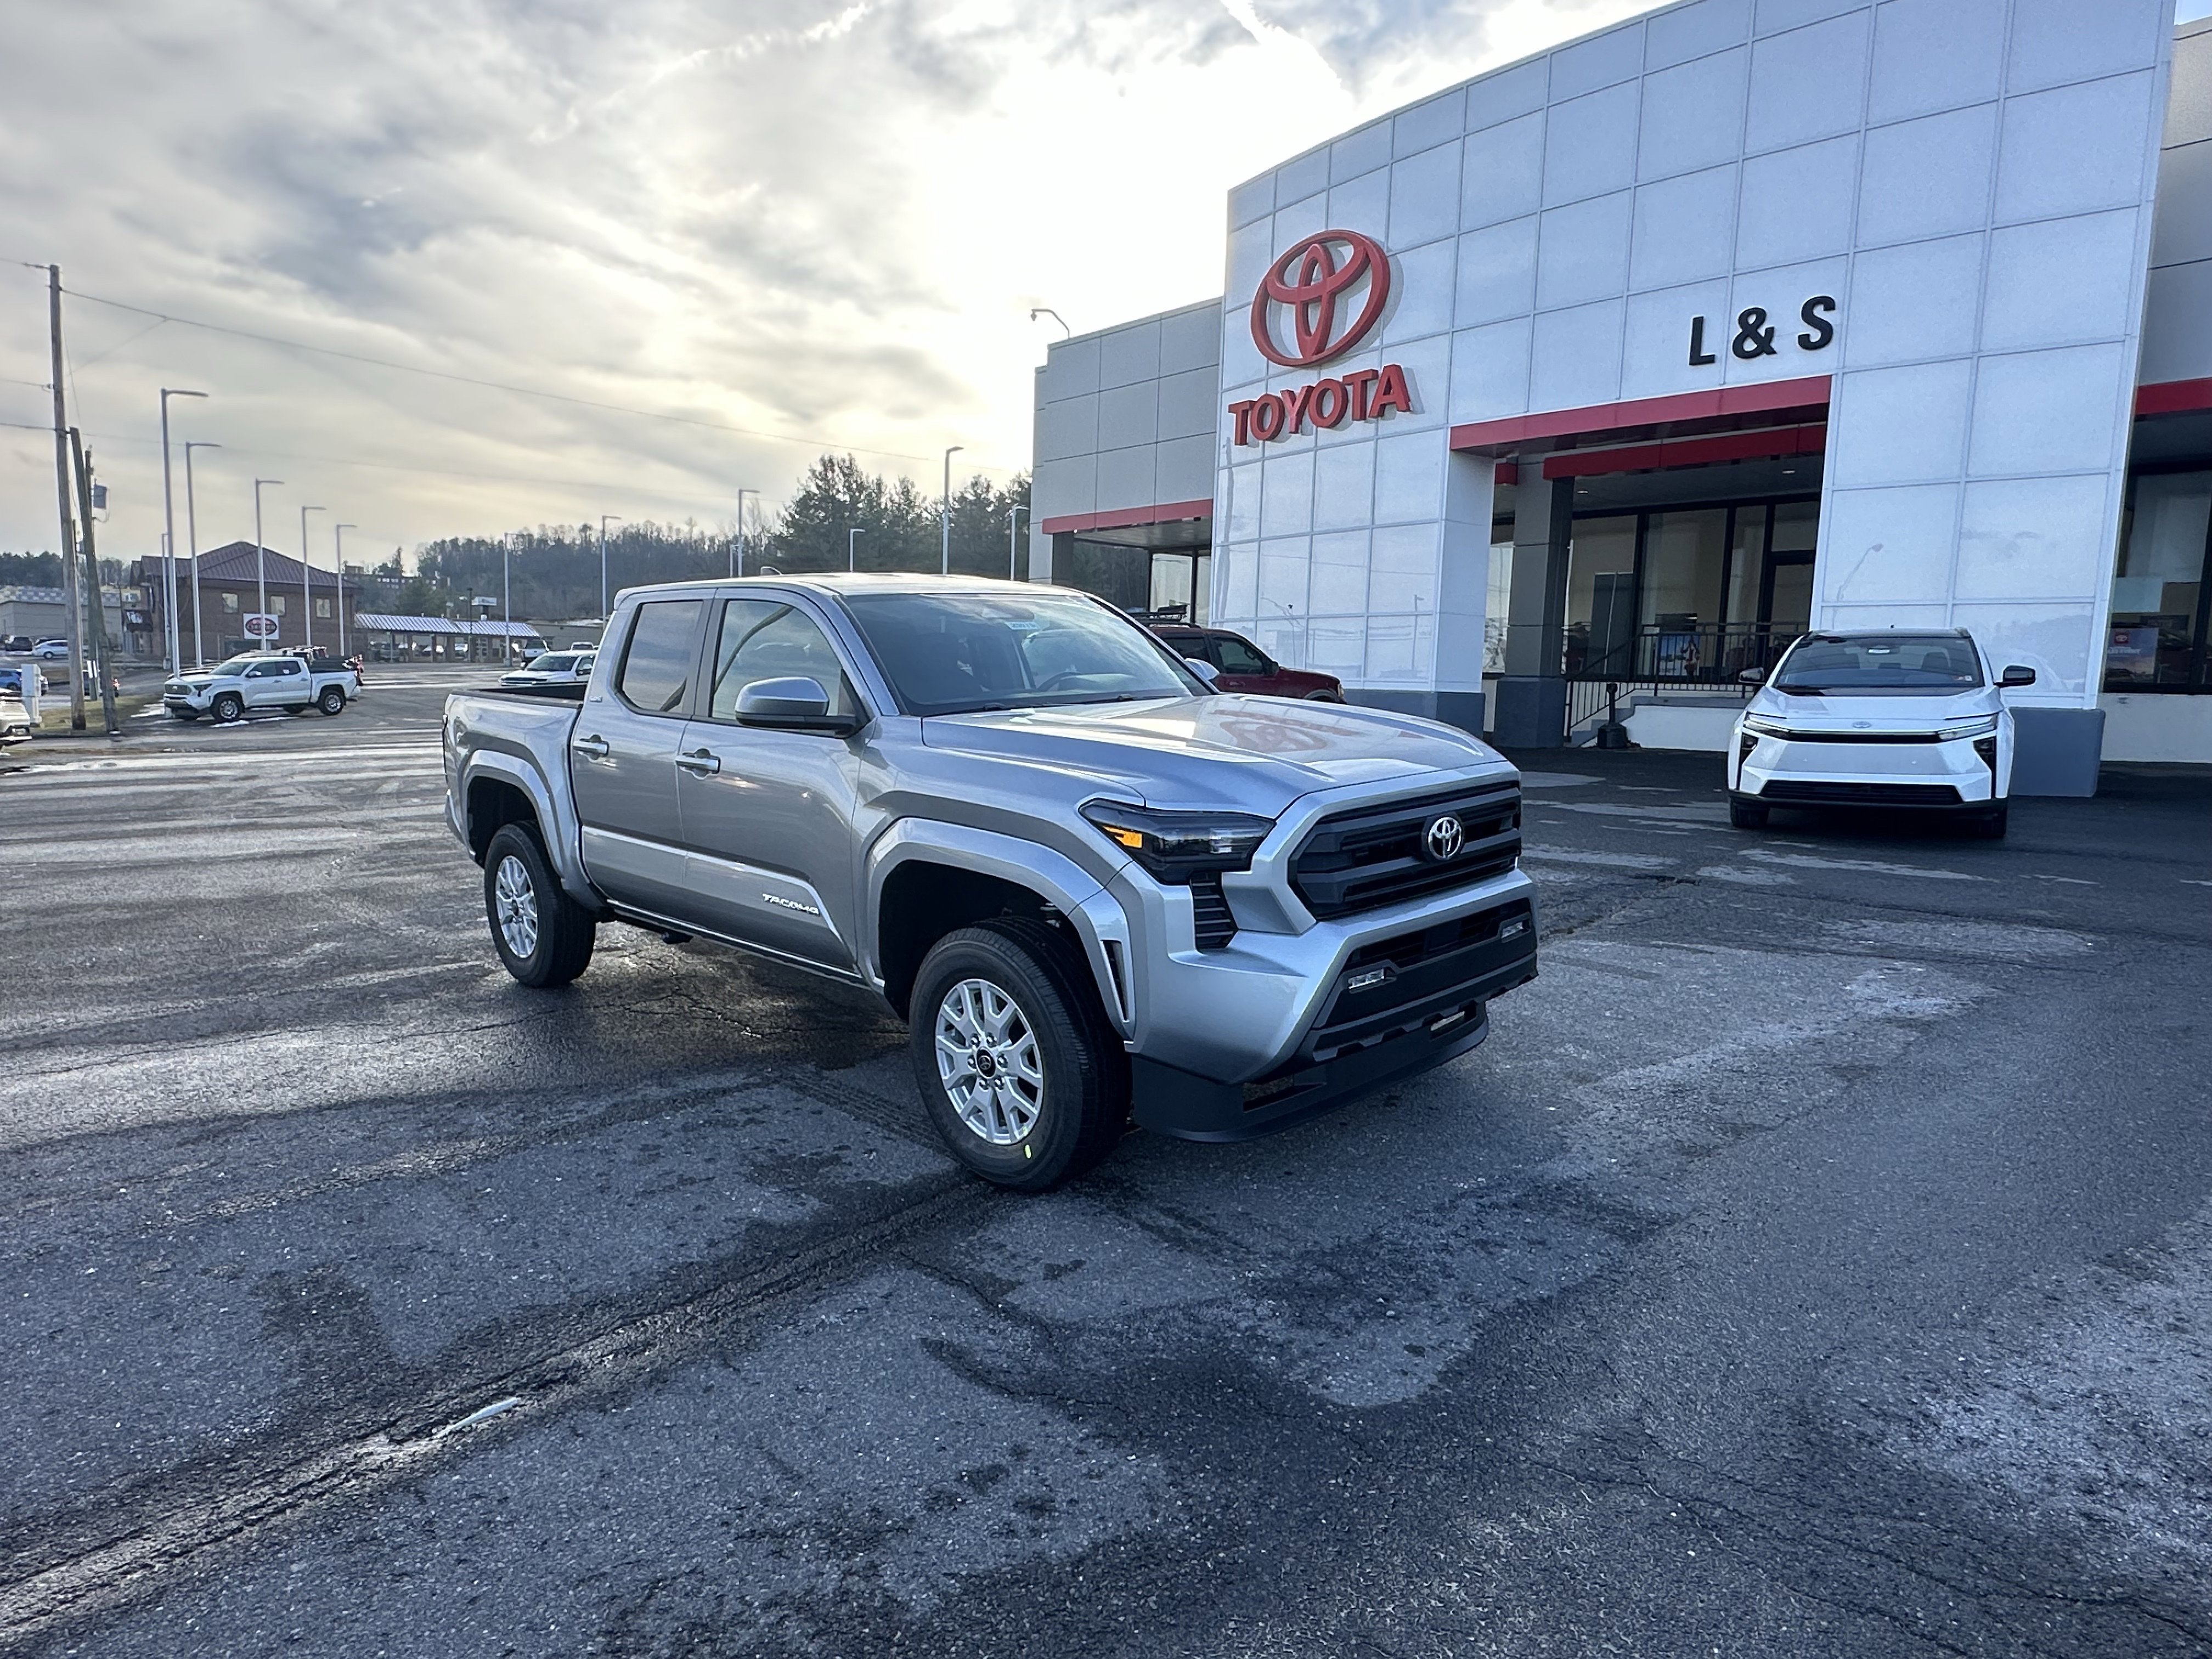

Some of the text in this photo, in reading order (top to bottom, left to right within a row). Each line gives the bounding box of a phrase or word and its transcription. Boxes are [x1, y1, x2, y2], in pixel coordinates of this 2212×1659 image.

[1689, 295, 1836, 366] L & S
[1228, 363, 1411, 447] TOYOTA
[761, 893, 820, 916] TACOMA
